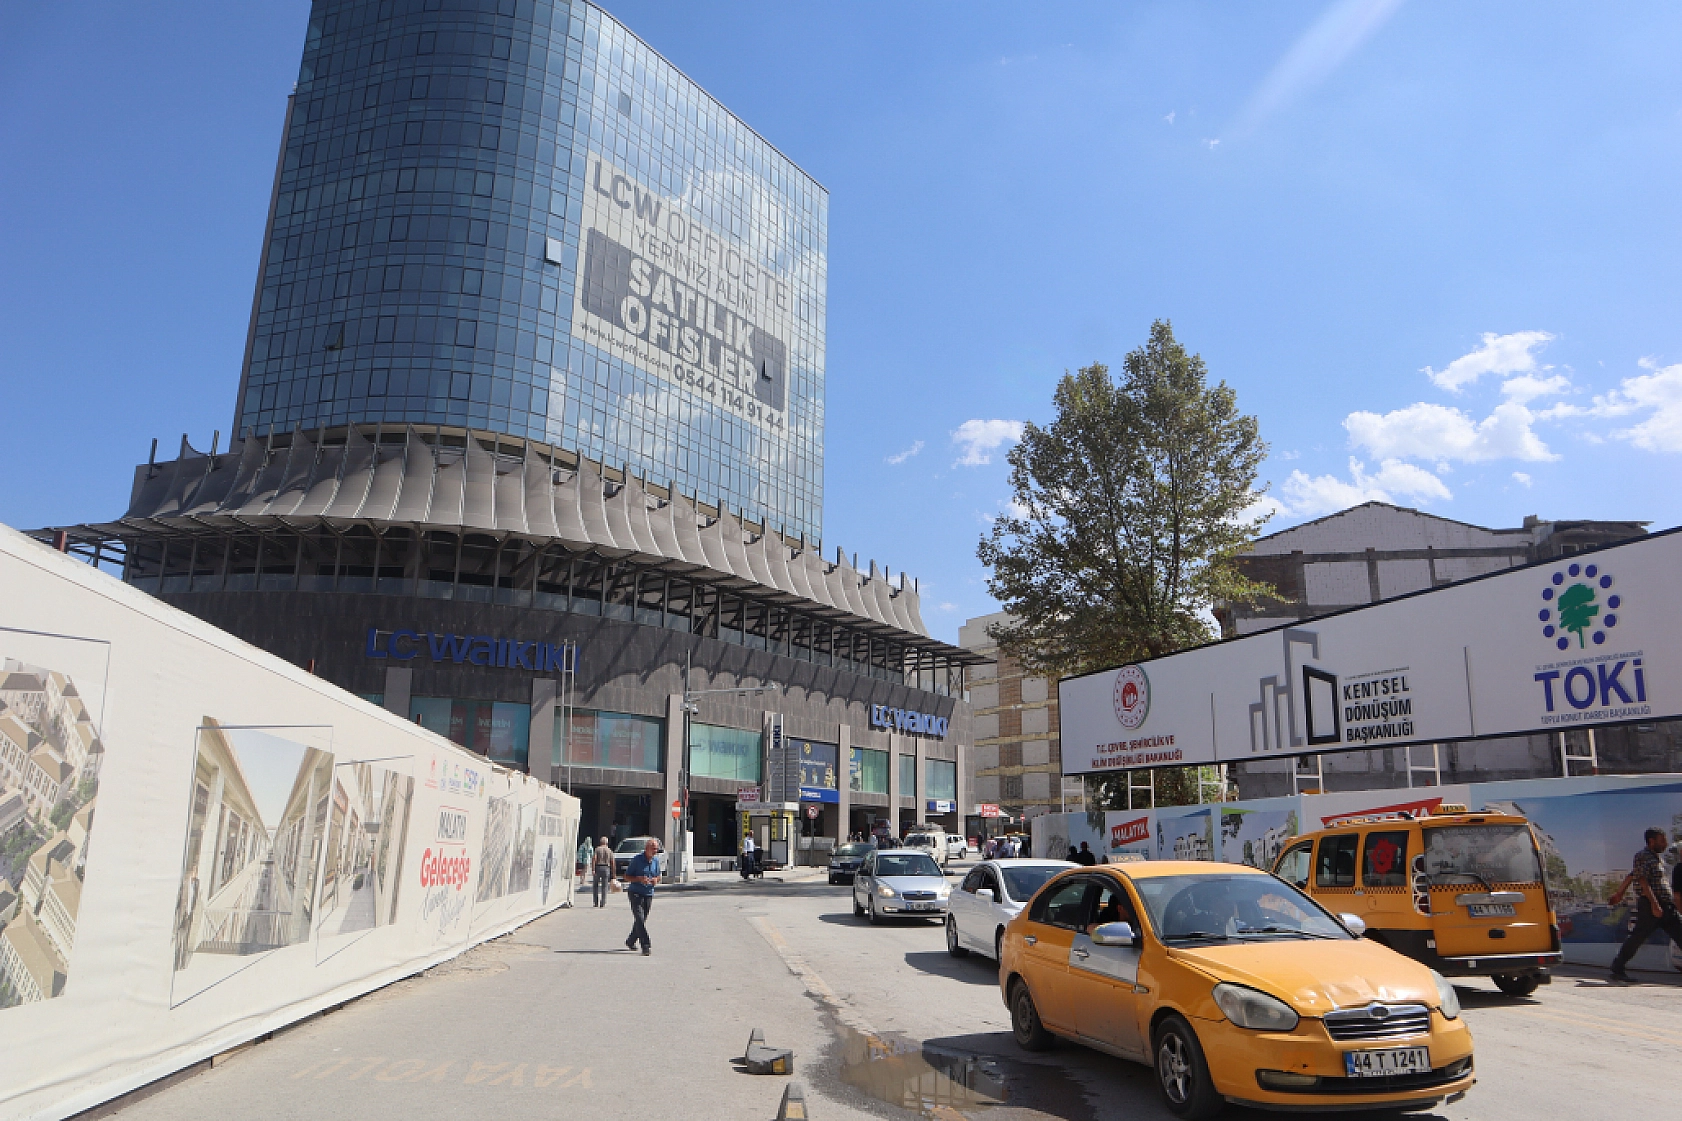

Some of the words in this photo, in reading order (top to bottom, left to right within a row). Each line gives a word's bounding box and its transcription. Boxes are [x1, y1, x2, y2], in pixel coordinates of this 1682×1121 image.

[592, 160, 662, 227] LCW
[629, 257, 755, 359] SATILIK
[673, 363, 717, 398] 0544
[721, 386, 743, 411] 114
[746, 400, 762, 421] 91
[764, 411, 784, 430] 44
[366, 627, 418, 660] LC
[1343, 675, 1410, 701] KENTSEL
[872, 703, 893, 728] LC
[1344, 695, 1412, 723] DÖNÜŞÜM
[1346, 718, 1415, 744] BAŞKANLIĞI
[1354, 1053, 1372, 1070] 44
[1376, 1053, 1386, 1069] T
[1391, 1050, 1425, 1068] 1241
